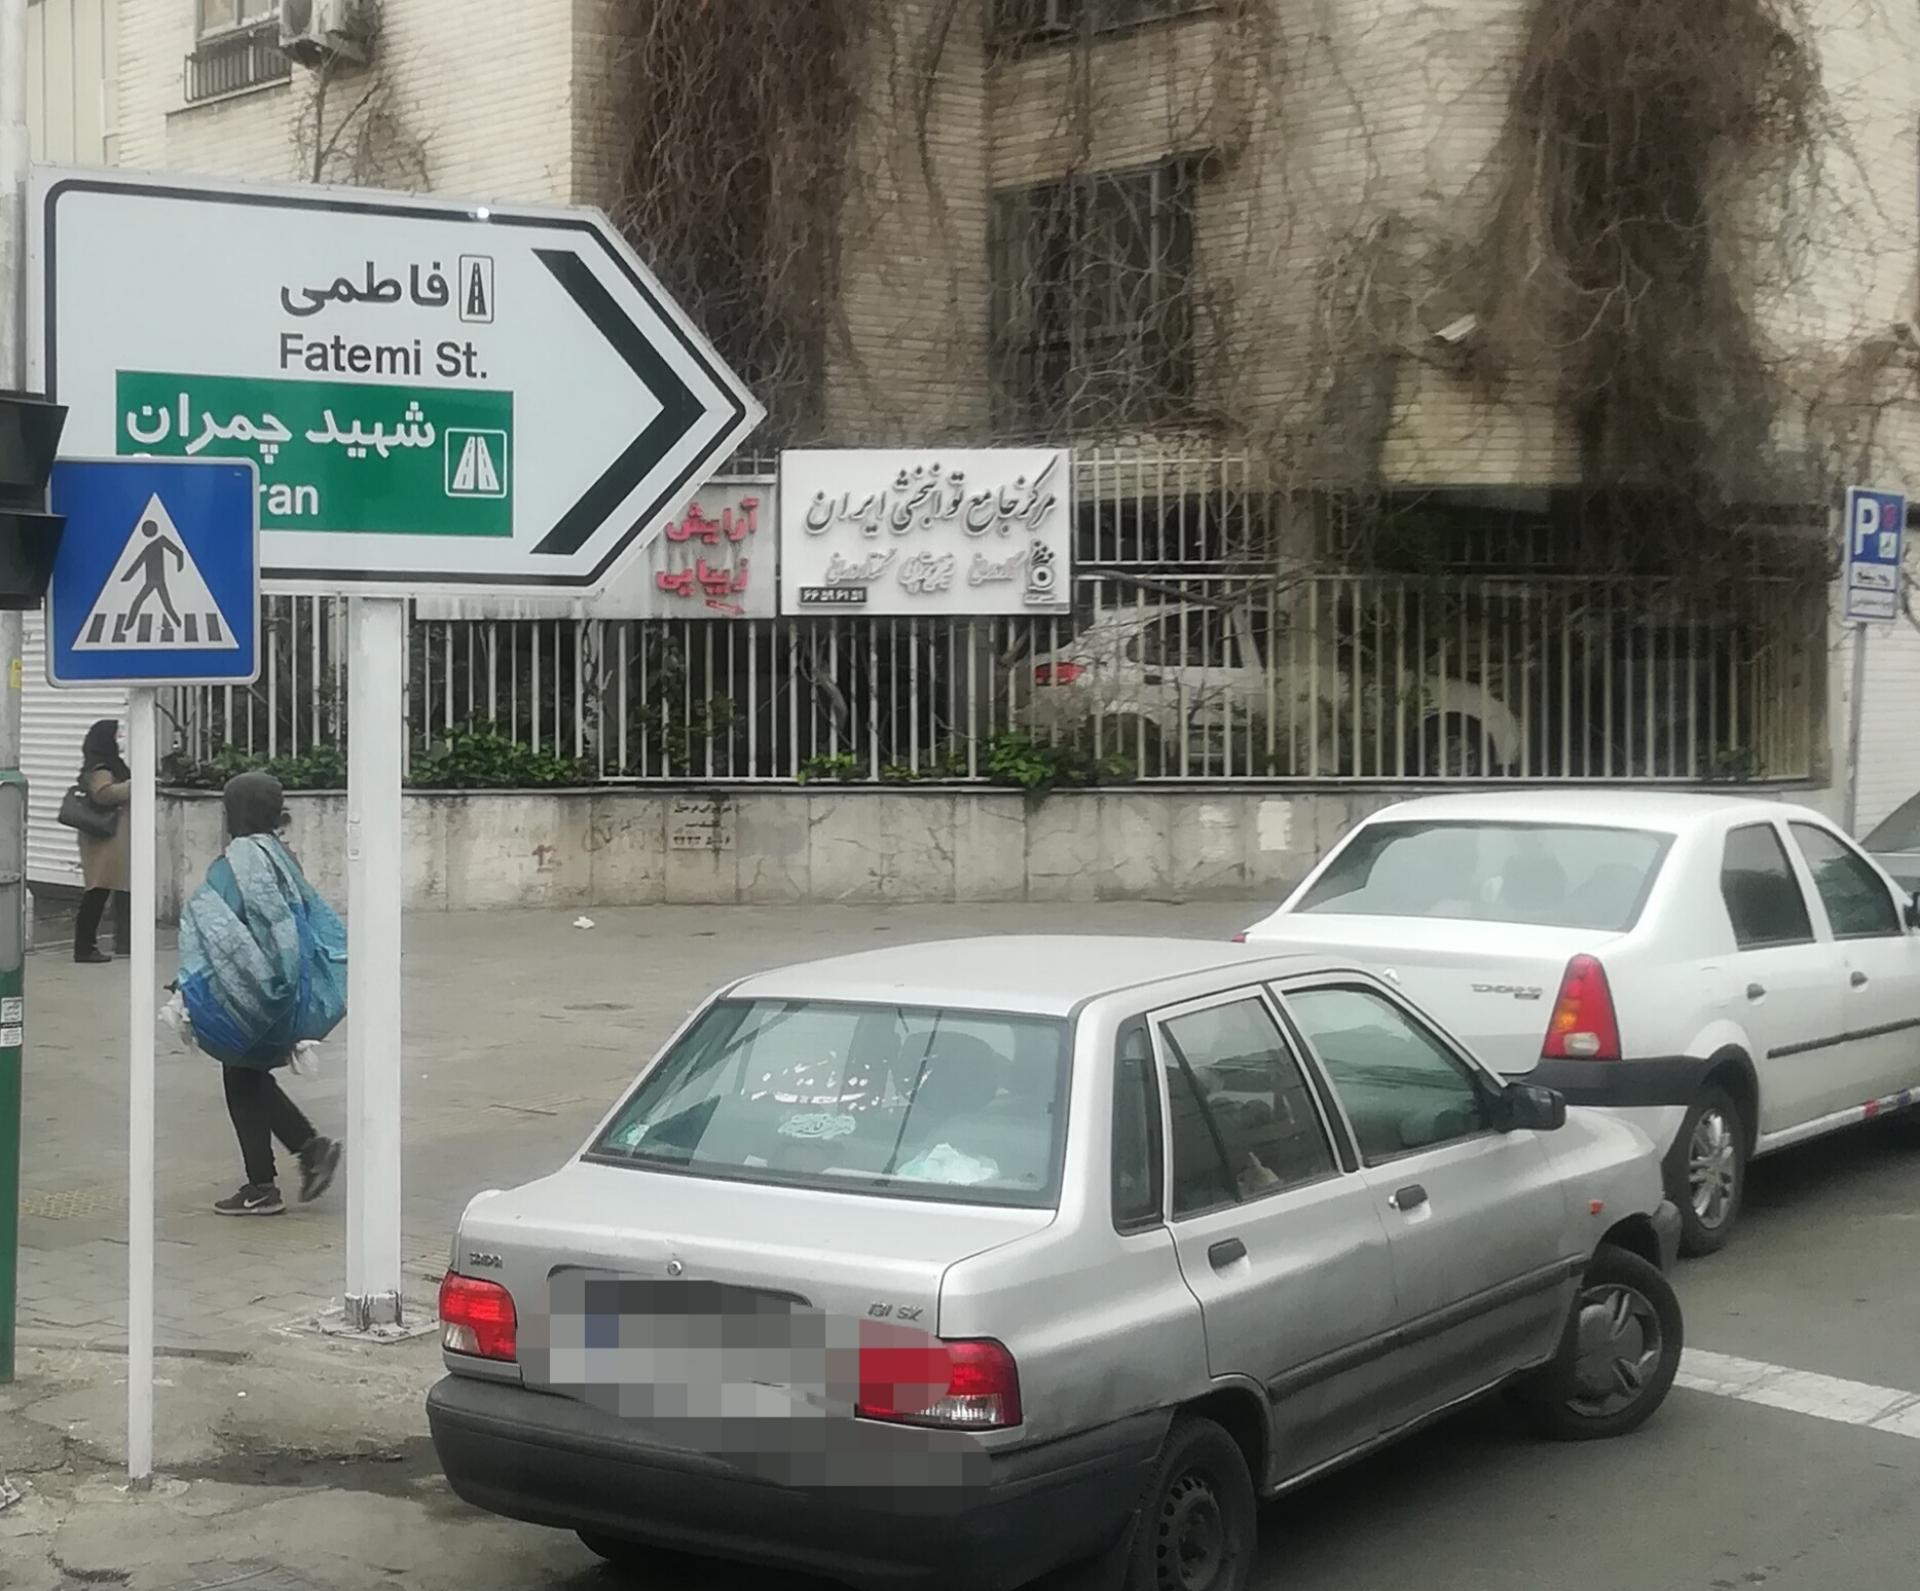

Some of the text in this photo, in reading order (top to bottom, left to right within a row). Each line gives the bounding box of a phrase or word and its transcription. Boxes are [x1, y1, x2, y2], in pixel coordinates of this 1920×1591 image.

[281, 260, 449, 317] فاطمی
[280, 332, 487, 379] Fatemi St.
[126, 392, 436, 464] شهید چمران
[806, 490, 886, 533] ایران
[966, 484, 1019, 533] جامع
[1016, 454, 1059, 528] مرکز
[665, 497, 758, 543] آرایش
[1854, 498, 1881, 556] P
[656, 558, 748, 598] زیبایی
